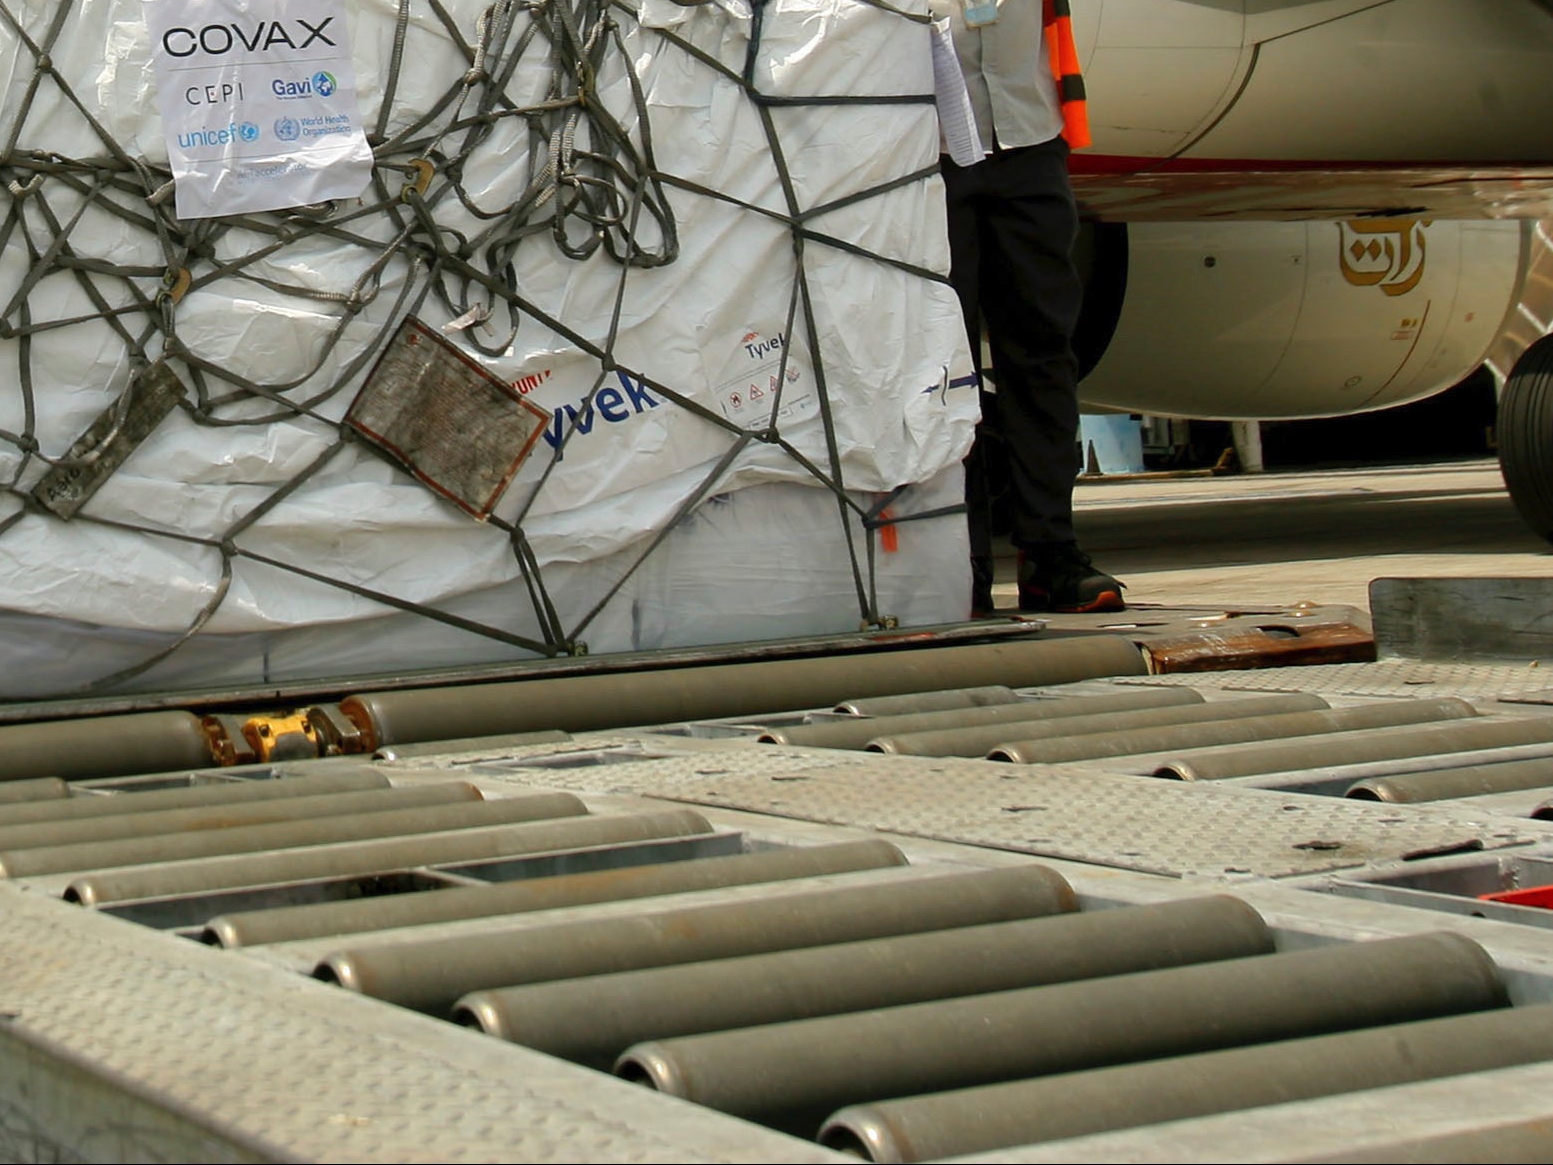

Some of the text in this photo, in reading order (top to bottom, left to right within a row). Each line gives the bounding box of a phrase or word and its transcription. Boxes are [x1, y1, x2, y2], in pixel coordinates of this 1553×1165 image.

[161, 16, 337, 58] COVAX
[185, 82, 244, 106] CEPI
[271, 77, 312, 96] Gavi
[177, 122, 238, 149] unicef
[542, 369, 660, 463] yvek
